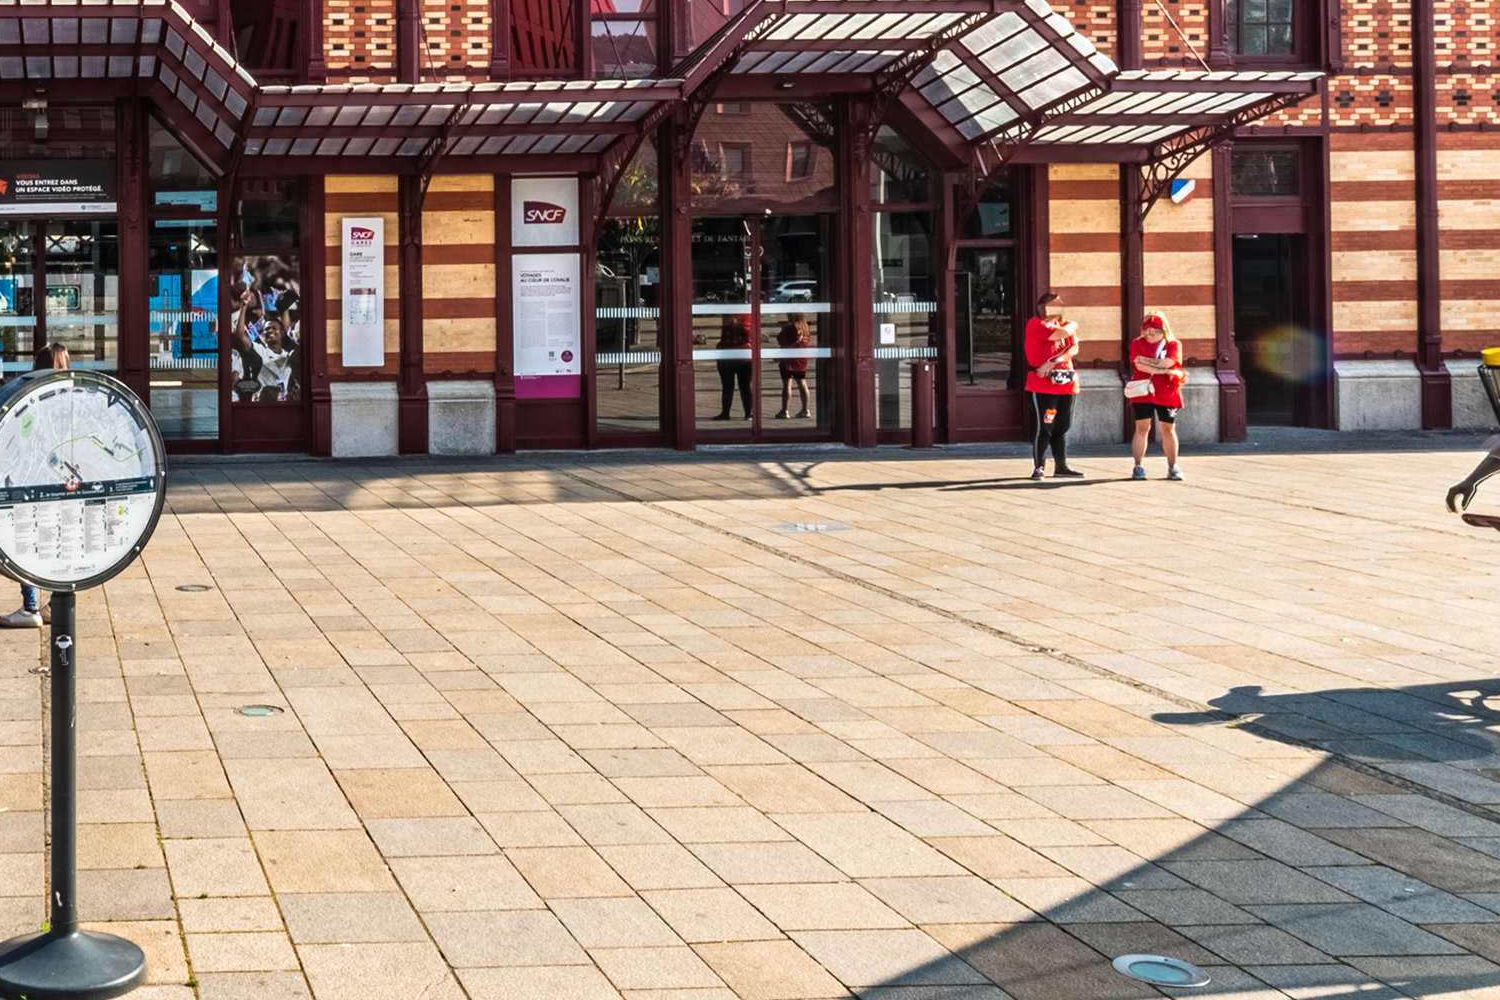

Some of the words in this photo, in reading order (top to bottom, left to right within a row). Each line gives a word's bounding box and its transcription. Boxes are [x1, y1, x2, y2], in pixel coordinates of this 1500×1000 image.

[60, 178, 78, 186] DANS
[51, 185, 72, 193] VIDÉO
[526, 208, 564, 223] SNCF
[352, 231, 374, 239] SNCF
